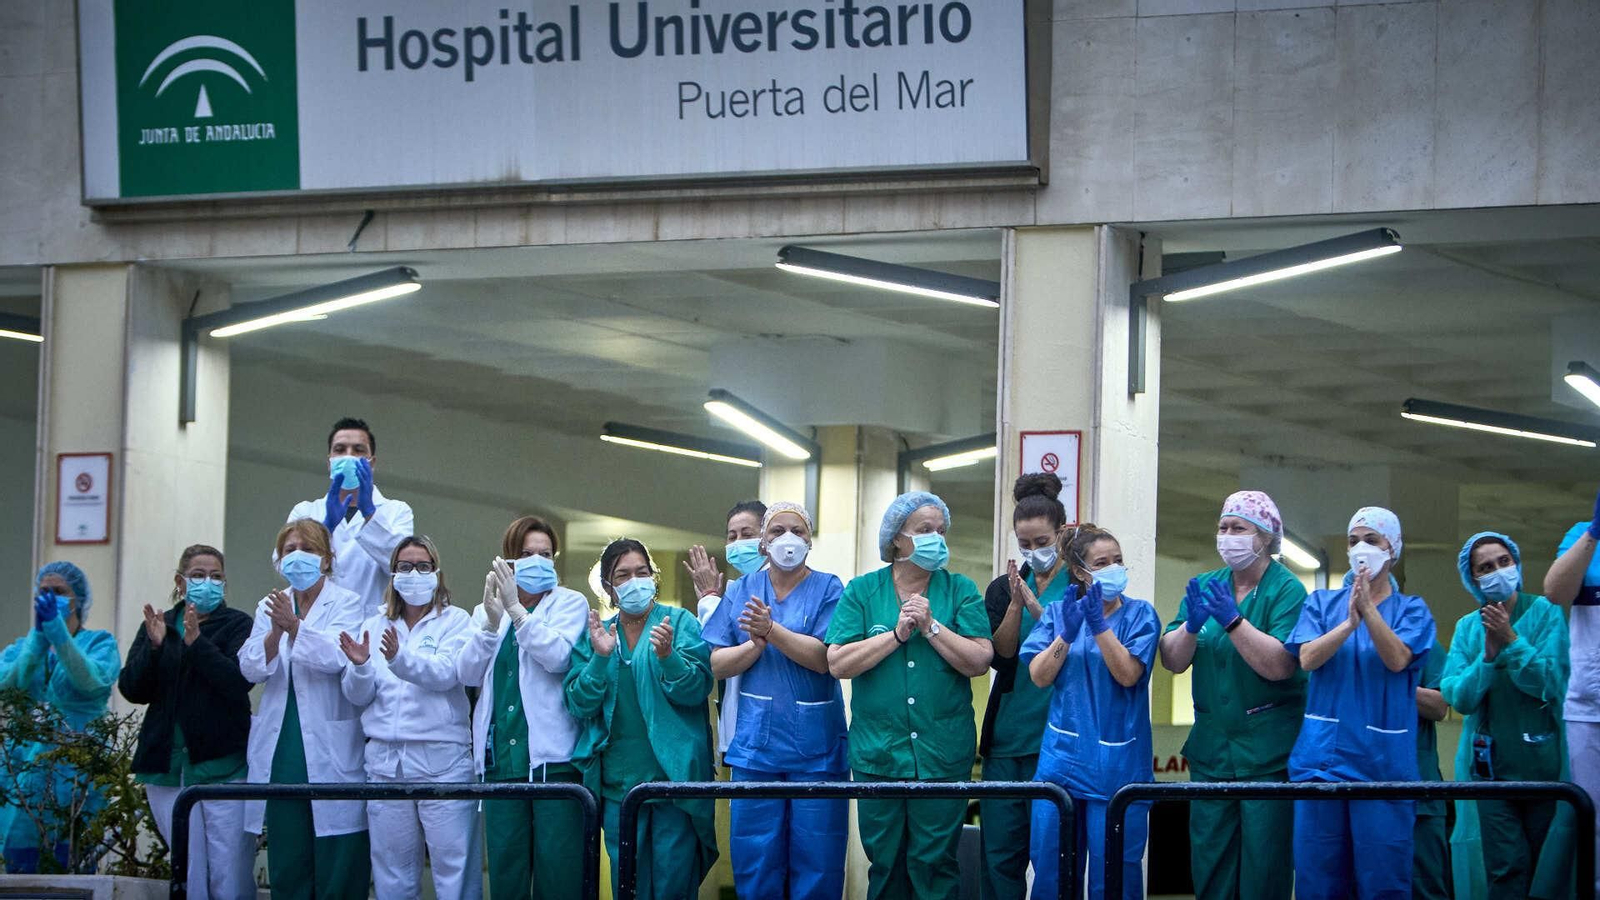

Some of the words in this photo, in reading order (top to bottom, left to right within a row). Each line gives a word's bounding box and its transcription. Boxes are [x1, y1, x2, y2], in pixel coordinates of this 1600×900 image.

[357, 5, 581, 82] Hospital
[609, 0, 972, 58] Universitario
[678, 79, 804, 120] Puerta
[823, 73, 878, 114] del
[897, 70, 974, 110] Mar
[139, 127, 180, 145] JUNTA
[184, 126, 201, 143] DE
